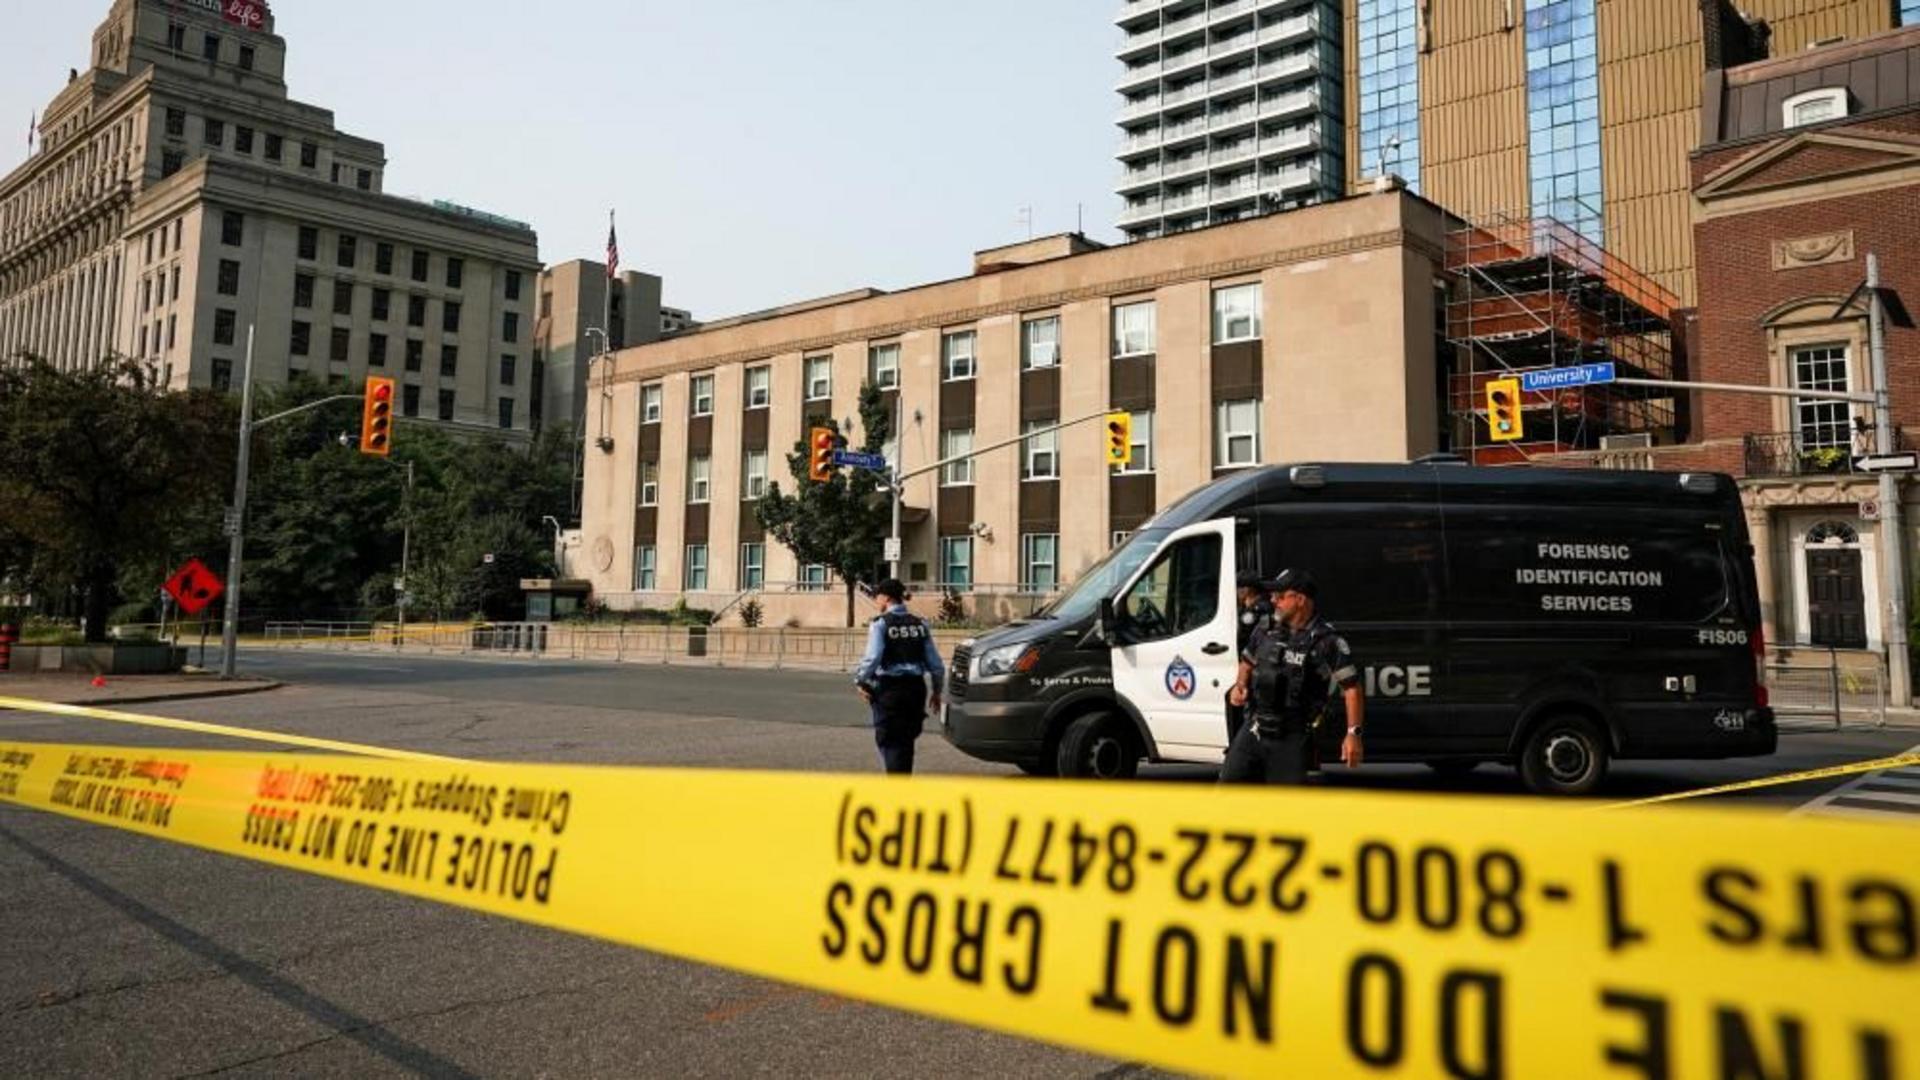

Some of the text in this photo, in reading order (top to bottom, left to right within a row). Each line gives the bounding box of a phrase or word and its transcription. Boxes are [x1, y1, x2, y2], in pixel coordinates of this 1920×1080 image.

[1529, 367, 1593, 387] University
[1538, 543, 1630, 560] FORENSIC
[1516, 568, 1663, 587] IDENTIFICATION
[1541, 595, 1633, 612] SERVICES
[1699, 629, 1748, 645] FIS06
[1364, 664, 1431, 697] ICE
[412, 774, 498, 827] Stoppers
[502, 787, 570, 834] Crime
[243, 804, 557, 903] POLICE LINE DO NOT CROSS
[836, 792, 975, 878] (TIPS)
[996, 816, 1648, 952] 1-800-222-8477
[822, 880, 1044, 996] CROSS
[1090, 918, 1275, 1045] NOT
[1345, 951, 1507, 1080] DO
